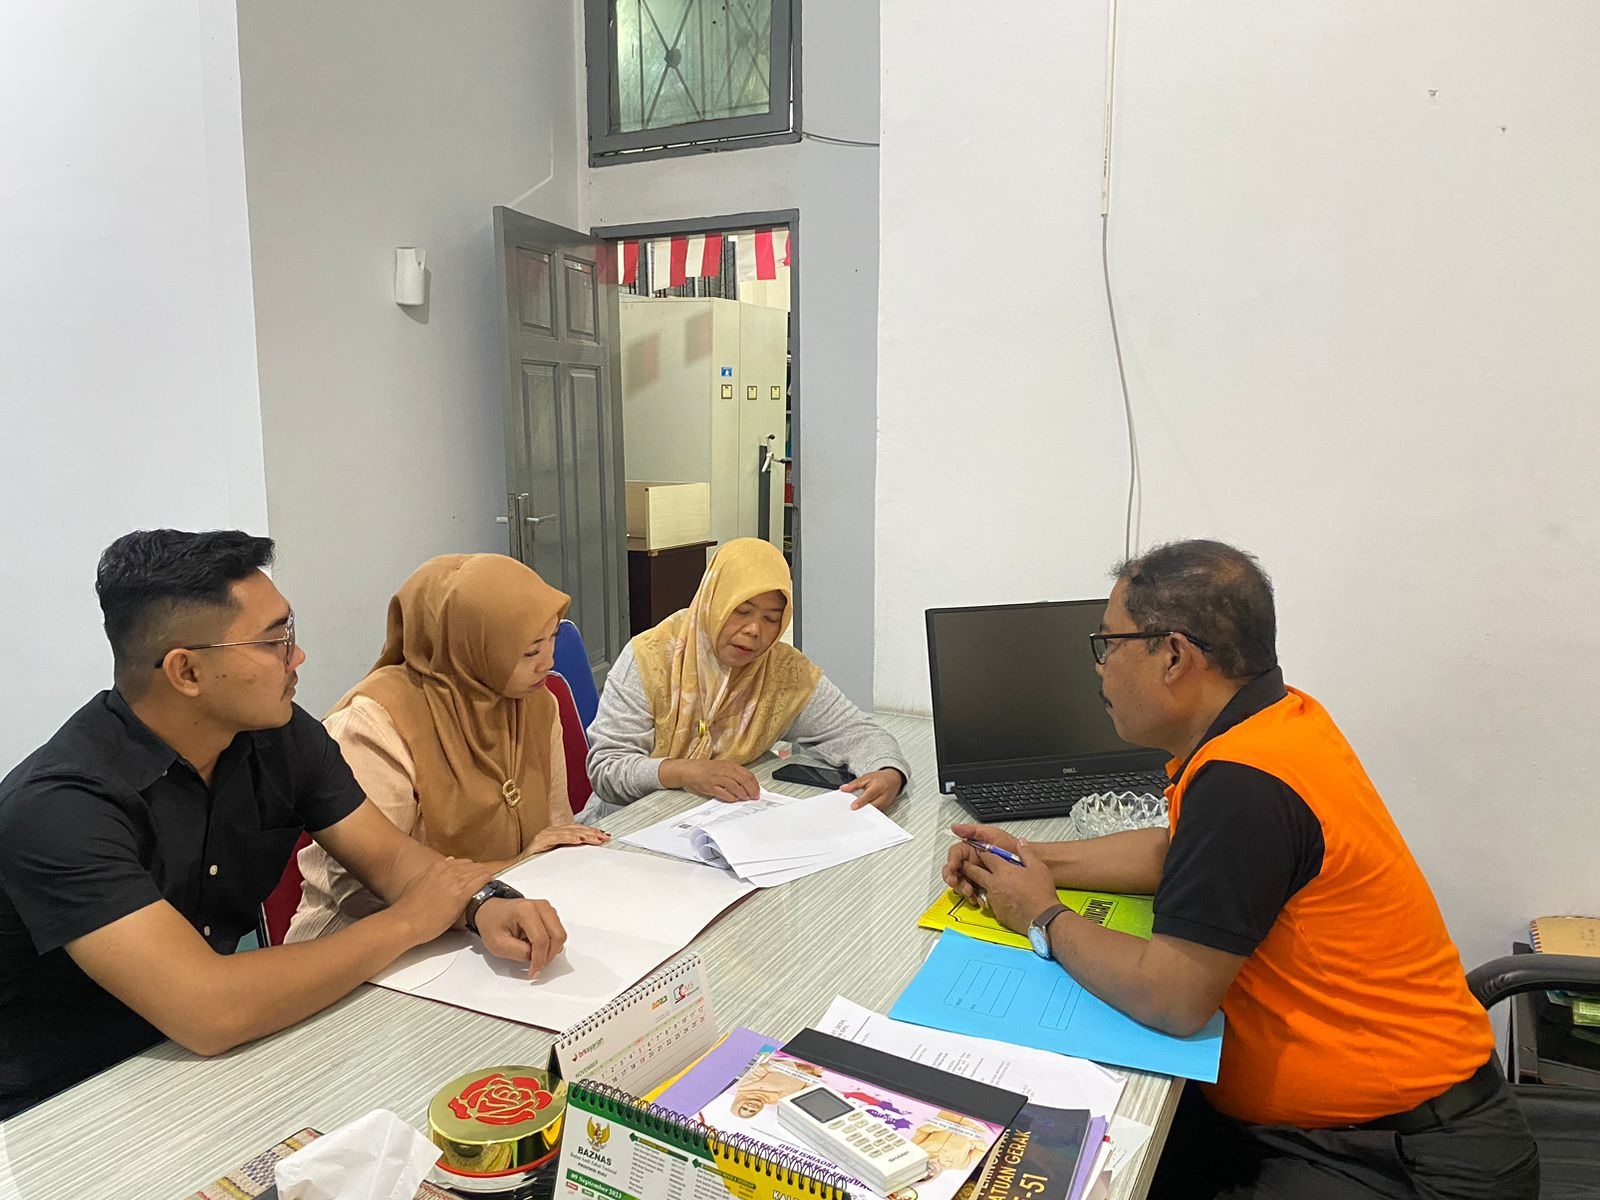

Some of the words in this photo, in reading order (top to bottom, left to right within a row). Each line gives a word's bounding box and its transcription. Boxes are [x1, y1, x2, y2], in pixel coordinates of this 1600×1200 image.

[578, 1146, 612, 1166] BAZNAS
[778, 1143, 799, 1154] RIAU
[1004, 1129, 1031, 1165] GERAK
[799, 1151, 838, 1169] PROVINSI
[579, 1176, 608, 1193] September
